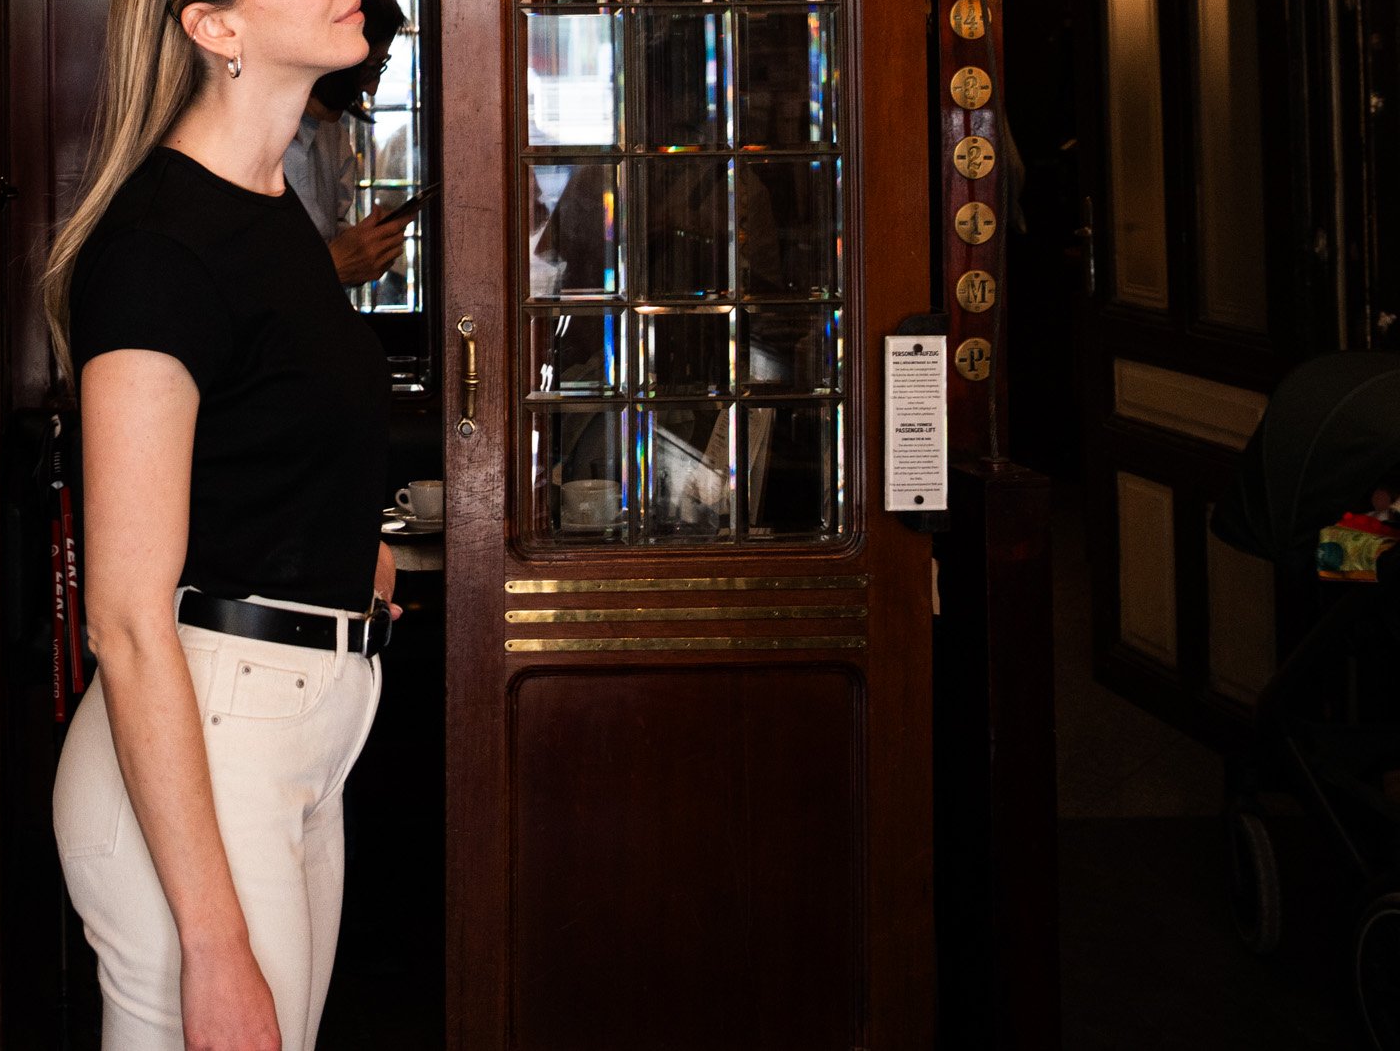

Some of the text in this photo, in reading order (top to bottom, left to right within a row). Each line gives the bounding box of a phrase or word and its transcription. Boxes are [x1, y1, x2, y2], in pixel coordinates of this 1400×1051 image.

[964, 76, 980, 101] 3
[967, 146, 981, 170] 2
[970, 210, 980, 235] 1
[967, 279, 988, 303] M
[967, 348, 983, 371] P
